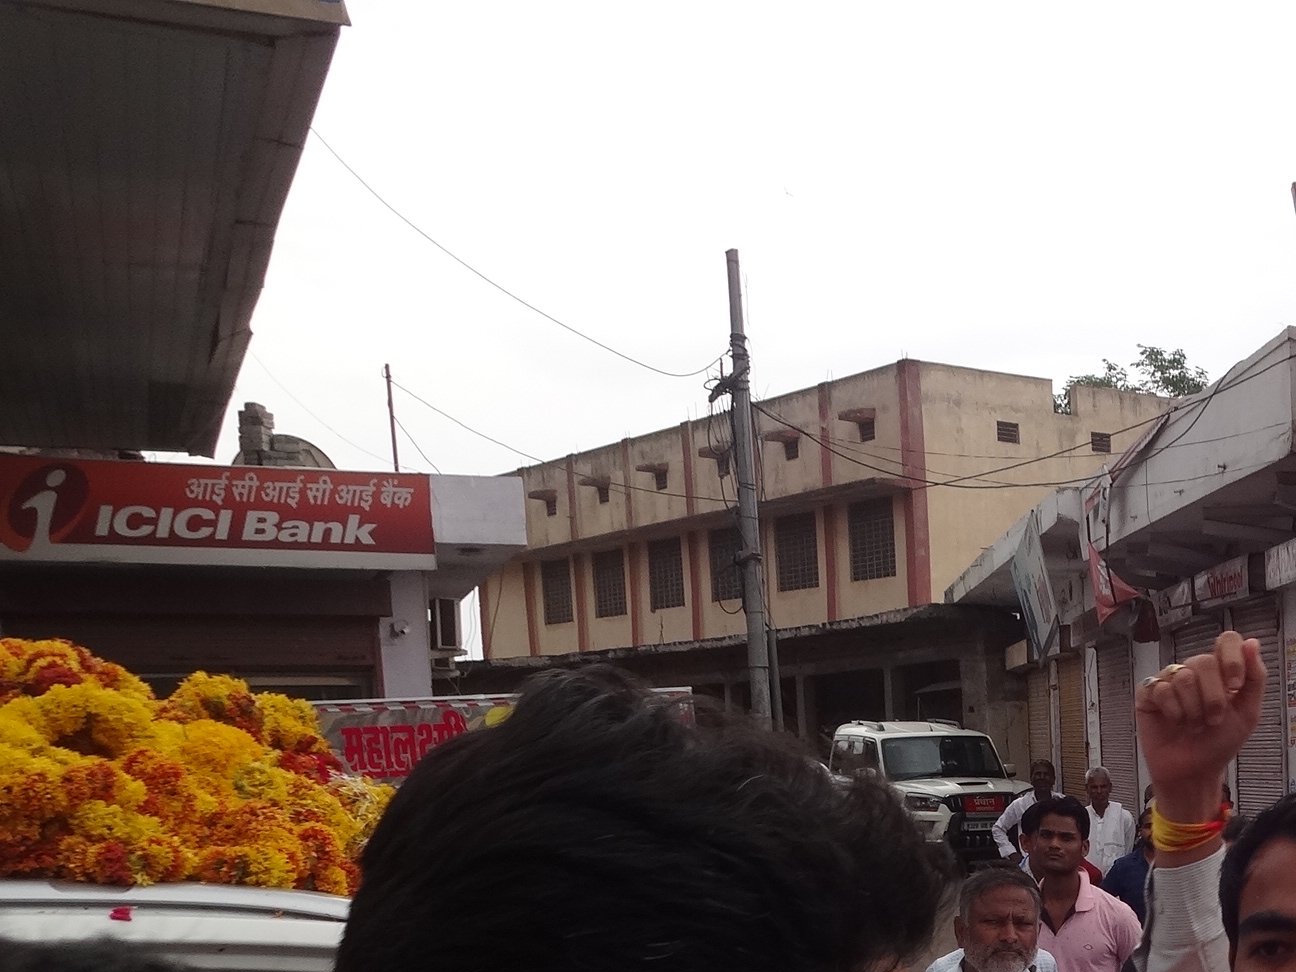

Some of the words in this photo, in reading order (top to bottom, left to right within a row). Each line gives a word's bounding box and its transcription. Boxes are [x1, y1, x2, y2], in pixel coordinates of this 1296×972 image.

[185, 472, 229, 506] आई
[231, 473, 259, 504] सी
[261, 475, 303, 509] आई
[305, 475, 333, 507] सी
[335, 478, 378, 511] आई
[380, 479, 414, 509] बैंक
[95, 505, 233, 541] ICICI
[241, 510, 378, 545] Bank
